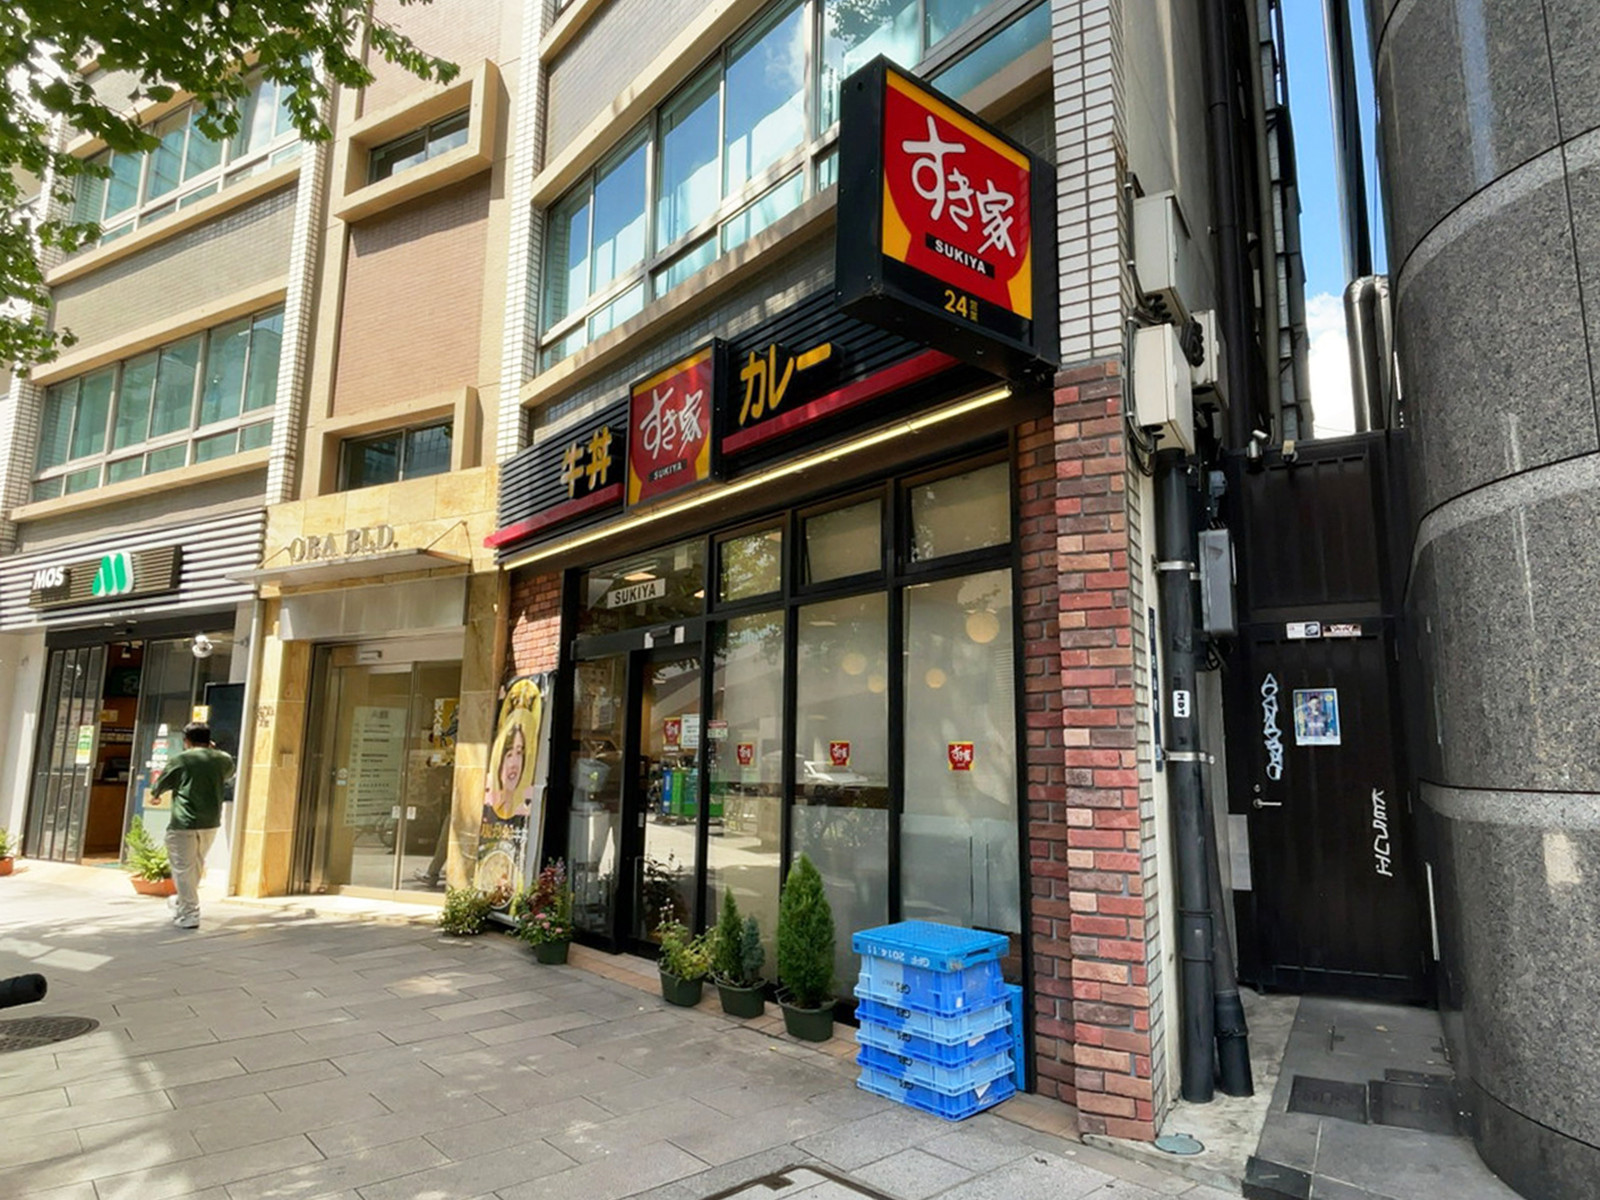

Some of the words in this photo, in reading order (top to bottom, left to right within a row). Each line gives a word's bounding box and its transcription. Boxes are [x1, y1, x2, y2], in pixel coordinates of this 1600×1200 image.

[902, 115, 1016, 258] すき家
[935, 239, 986, 274] SUKIYA
[944, 289, 967, 317] 24
[740, 342, 831, 426] カレー
[639, 386, 703, 460] すき家
[560, 426, 612, 497] 牛丼
[653, 464, 683, 480] SUKIYA
[289, 533, 338, 562] OBA
[33, 566, 65, 590] MOS
[615, 583, 657, 605] SUKIYA
